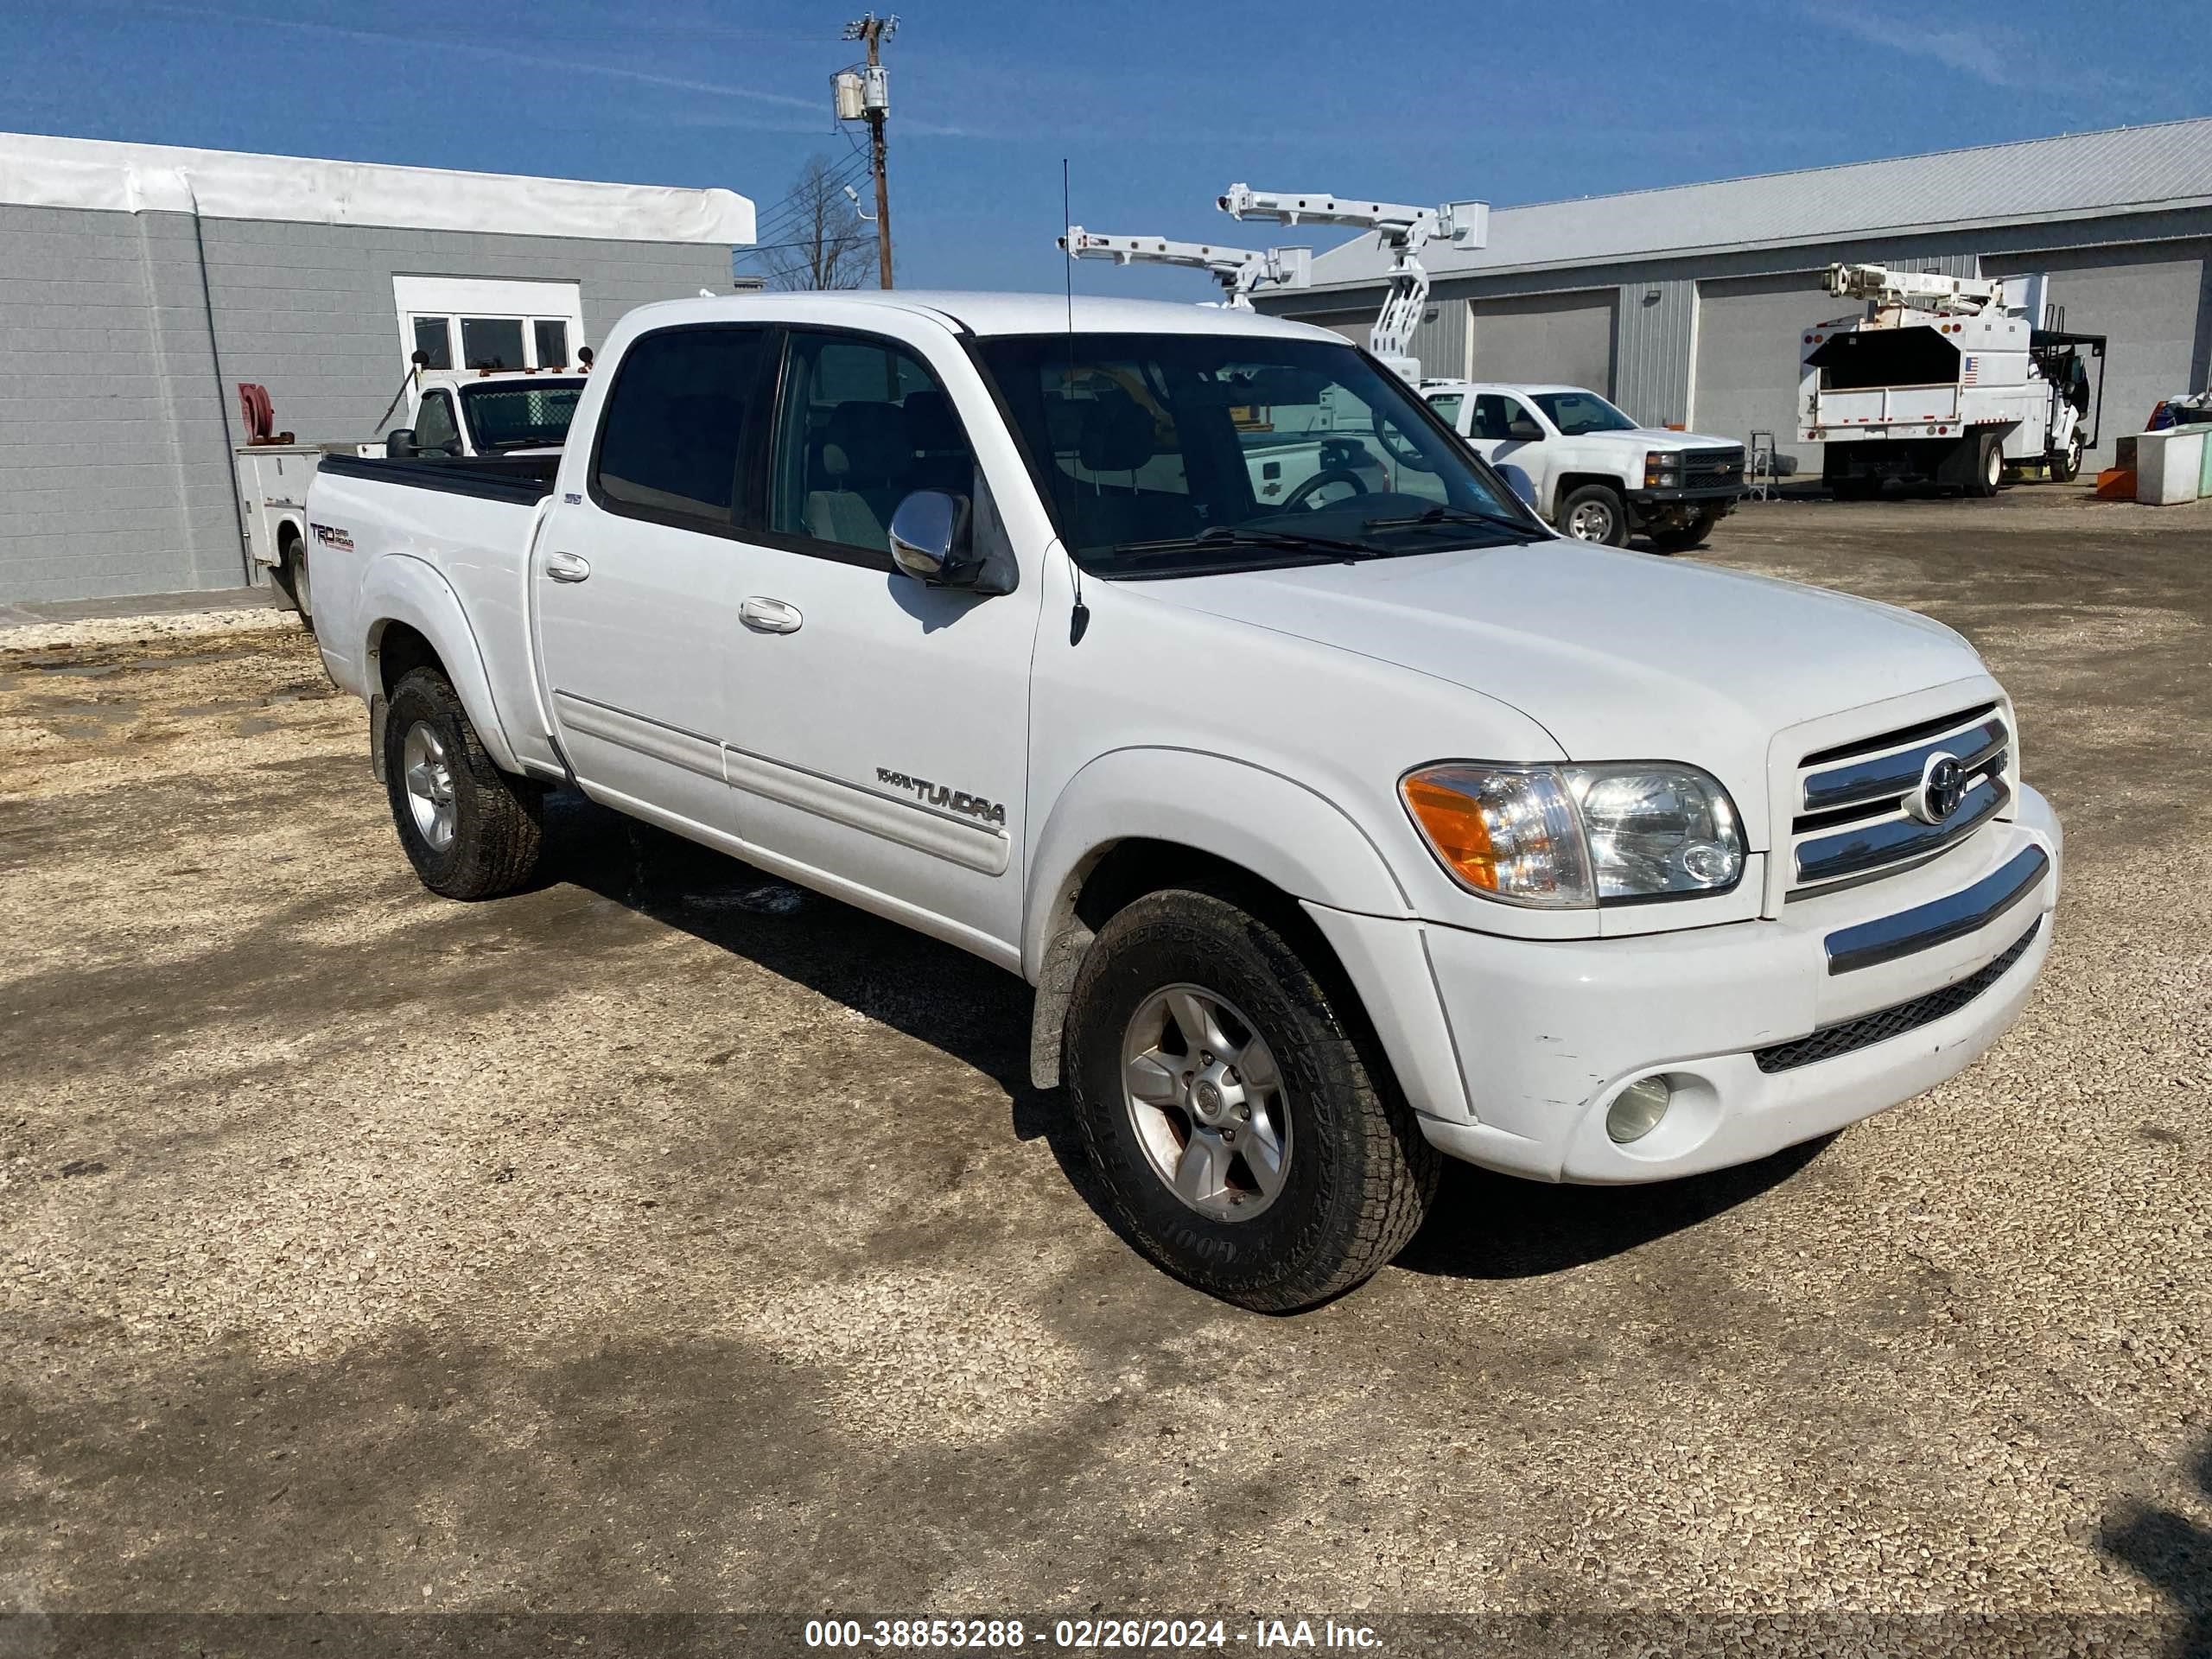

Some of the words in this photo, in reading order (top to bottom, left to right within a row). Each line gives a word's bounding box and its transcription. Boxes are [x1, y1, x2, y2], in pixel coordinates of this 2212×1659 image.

[309, 522, 334, 545] TRD
[335, 537, 354, 547] ROAD
[875, 766, 914, 791] TOYOTA
[912, 778, 1007, 825] TUNDRA
